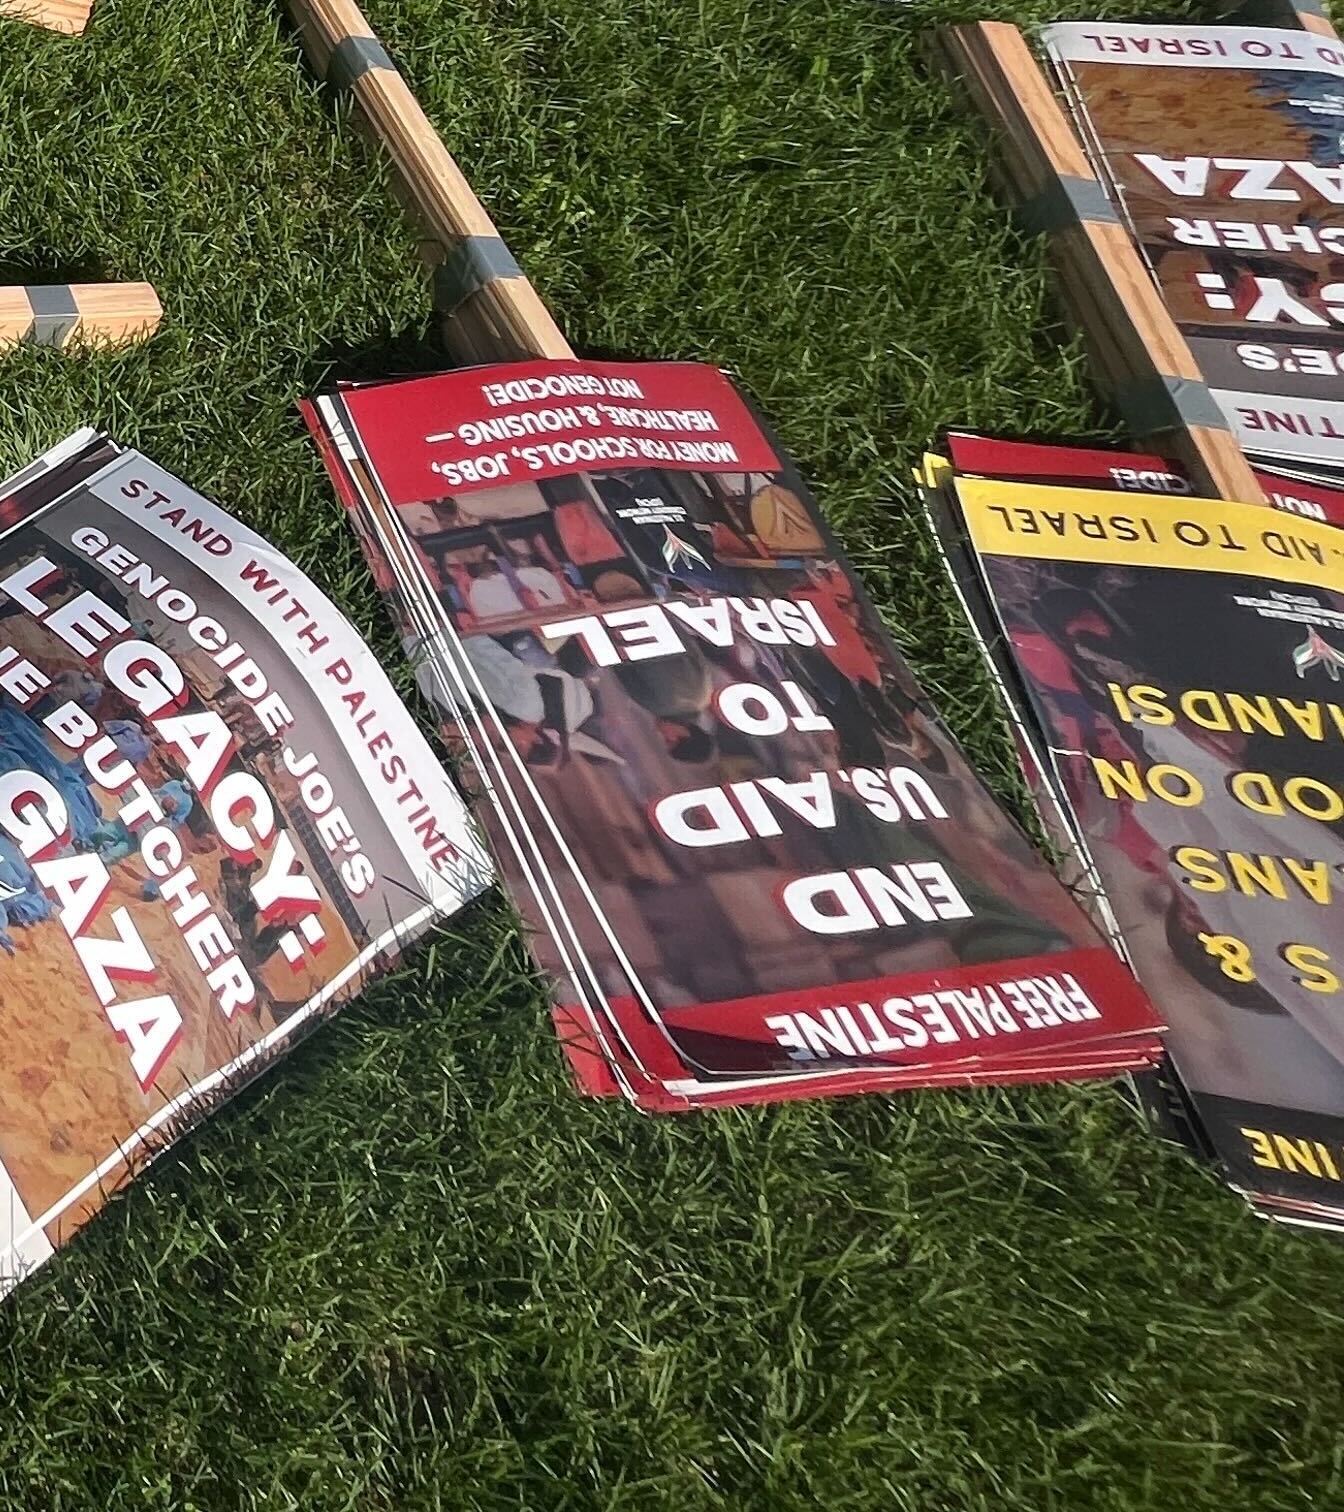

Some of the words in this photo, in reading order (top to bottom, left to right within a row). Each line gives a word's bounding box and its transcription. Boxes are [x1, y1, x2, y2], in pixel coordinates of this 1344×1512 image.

[1082, 33, 1227, 56] ISRAEL
[1239, 40, 1305, 59] TO
[988, 503, 1158, 545] ISRAEL
[1173, 521, 1248, 551] TO
[1262, 532, 1326, 566] AID
[540, 595, 839, 669] ISRAEL
[118, 475, 234, 559] STAND
[238, 557, 329, 651] WITH
[322, 658, 464, 874] PALESTINE
[69, 524, 294, 735] GENOCIDE
[284, 746, 379, 897] JOE'S
[717, 681, 835, 737] TO
[0, 552, 329, 971] LEGACY:
[1092, 756, 1206, 807] ON
[654, 775, 841, 848] AID
[865, 767, 950, 823] U.S.
[41, 700, 255, 1020] BUTCHER
[783, 861, 976, 936] END
[764, 985, 1021, 1061] PALESTINE
[1000, 972, 1102, 1030] FREE
